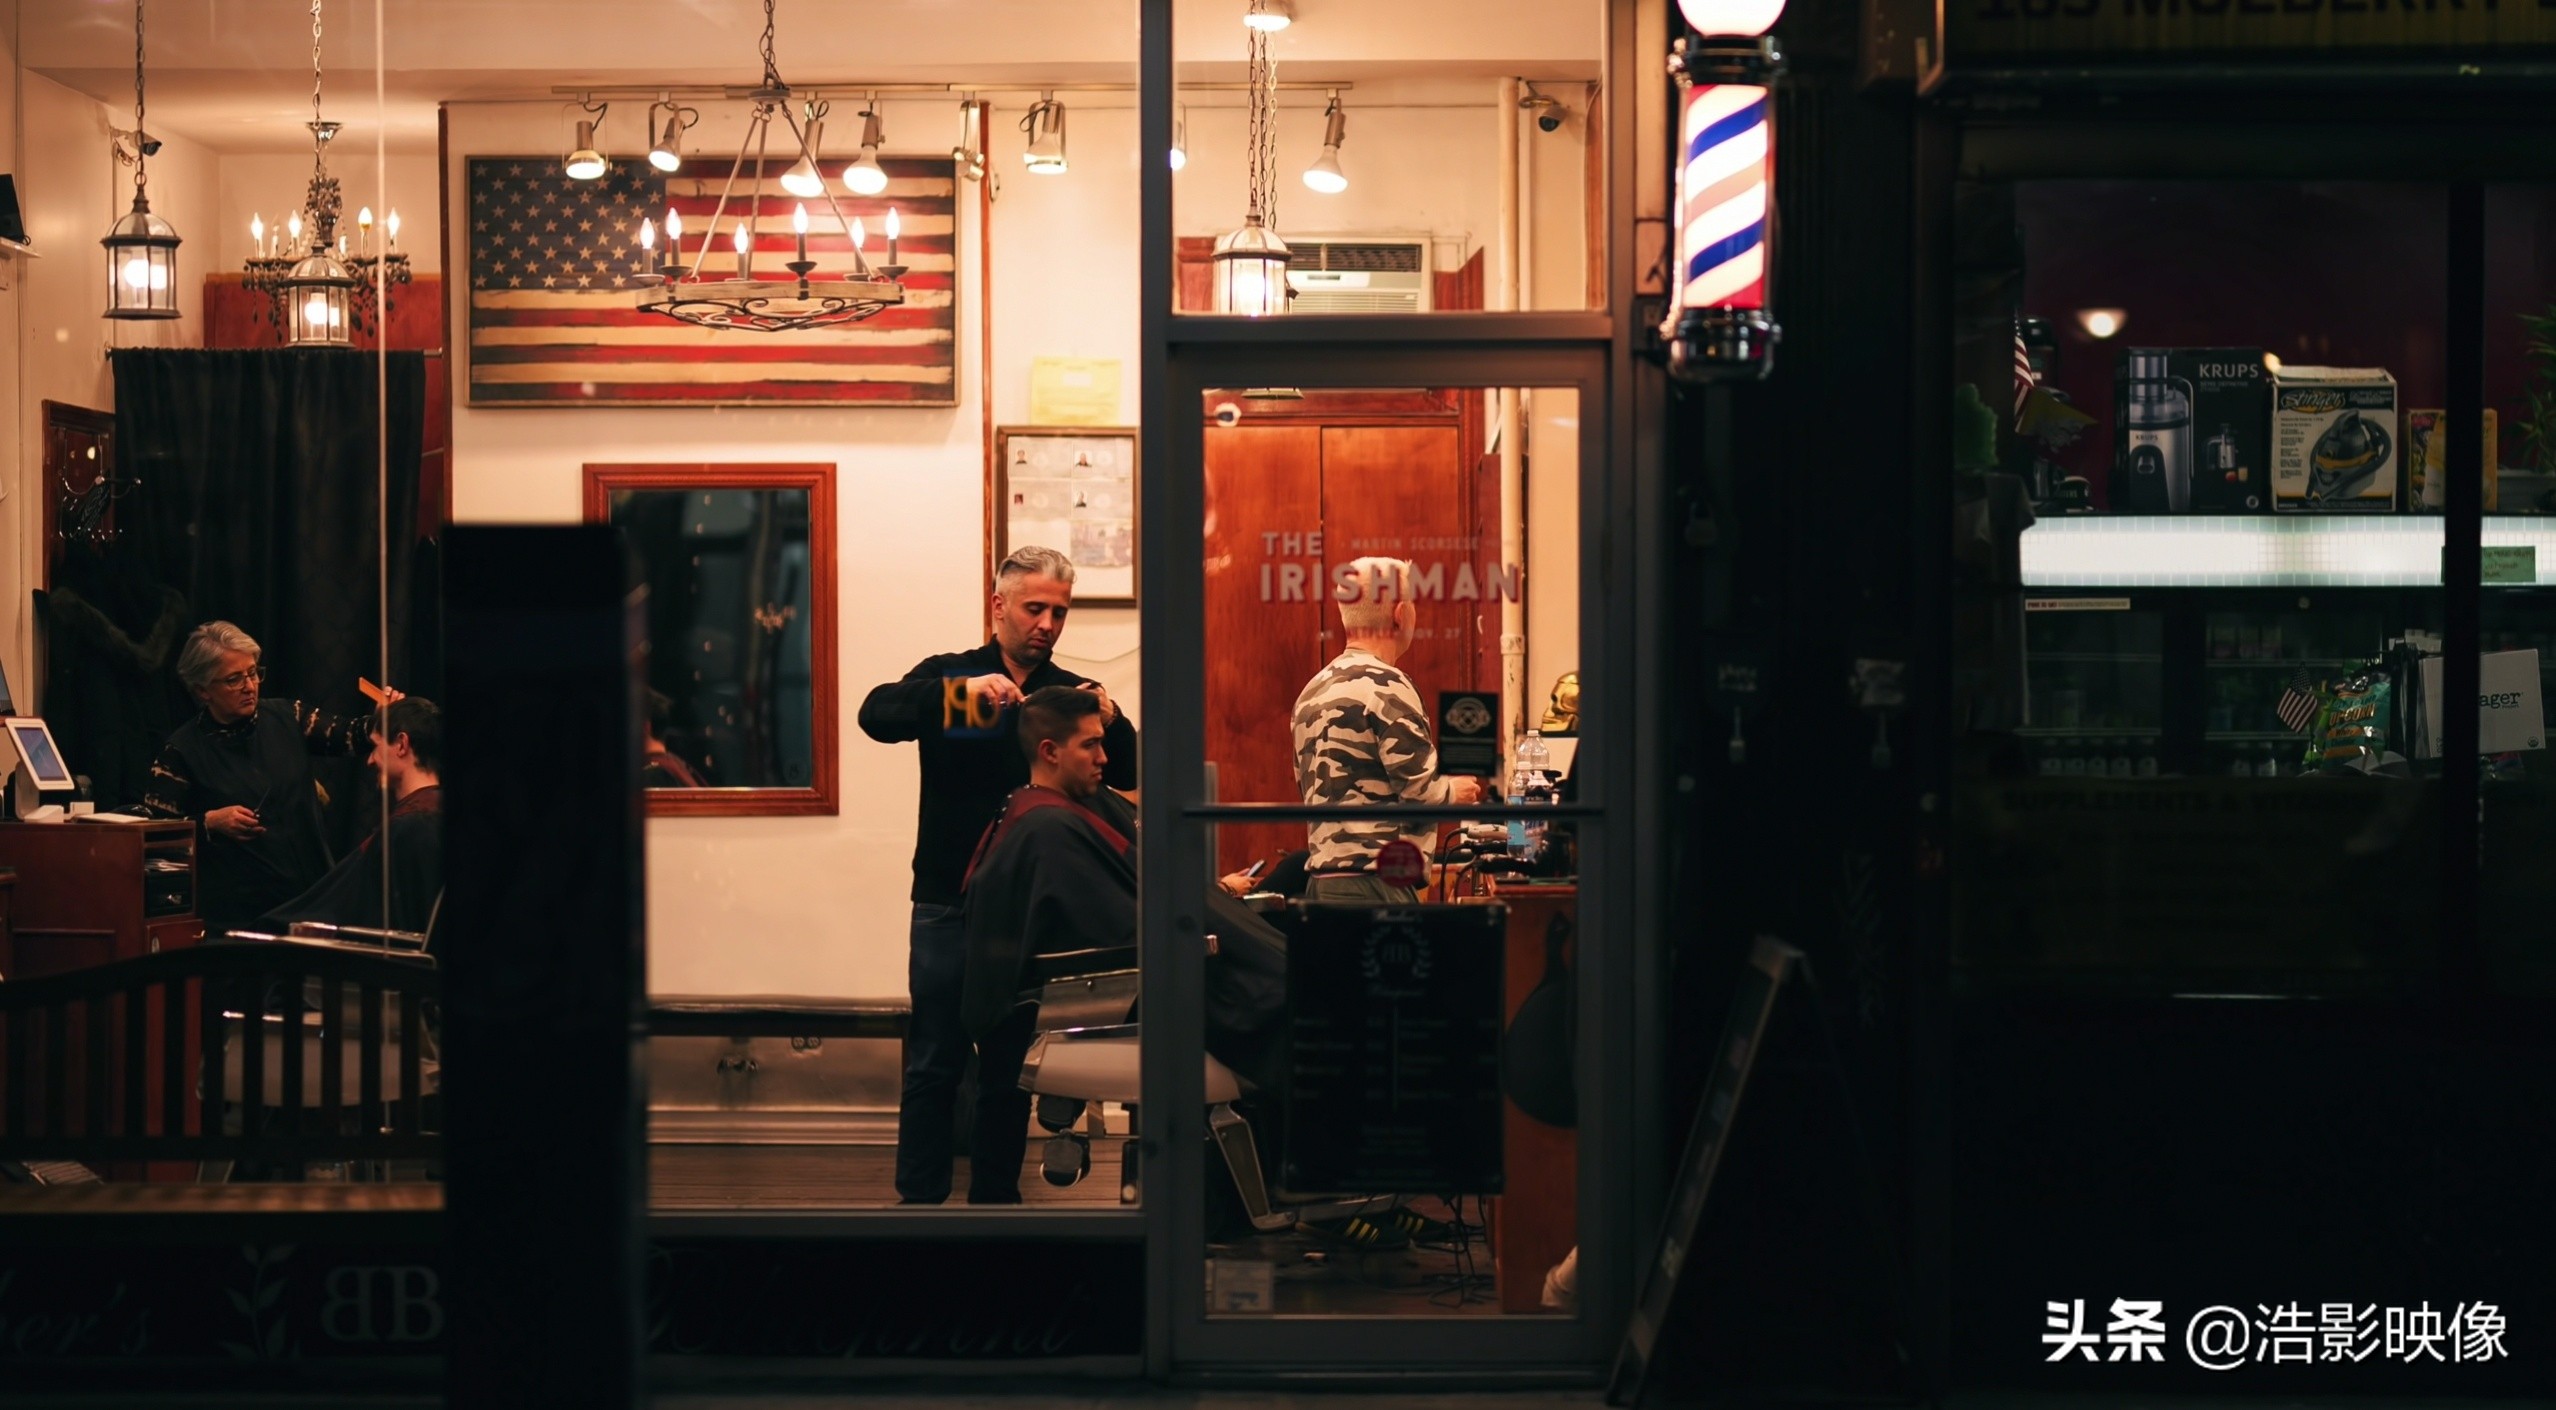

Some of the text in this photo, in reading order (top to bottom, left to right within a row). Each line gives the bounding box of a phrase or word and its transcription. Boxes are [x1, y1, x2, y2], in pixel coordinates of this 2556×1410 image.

[2199, 363, 2259, 378] KRUPS
[1260, 532, 1323, 556] THE
[1260, 561, 1520, 603] IRISHMAN
